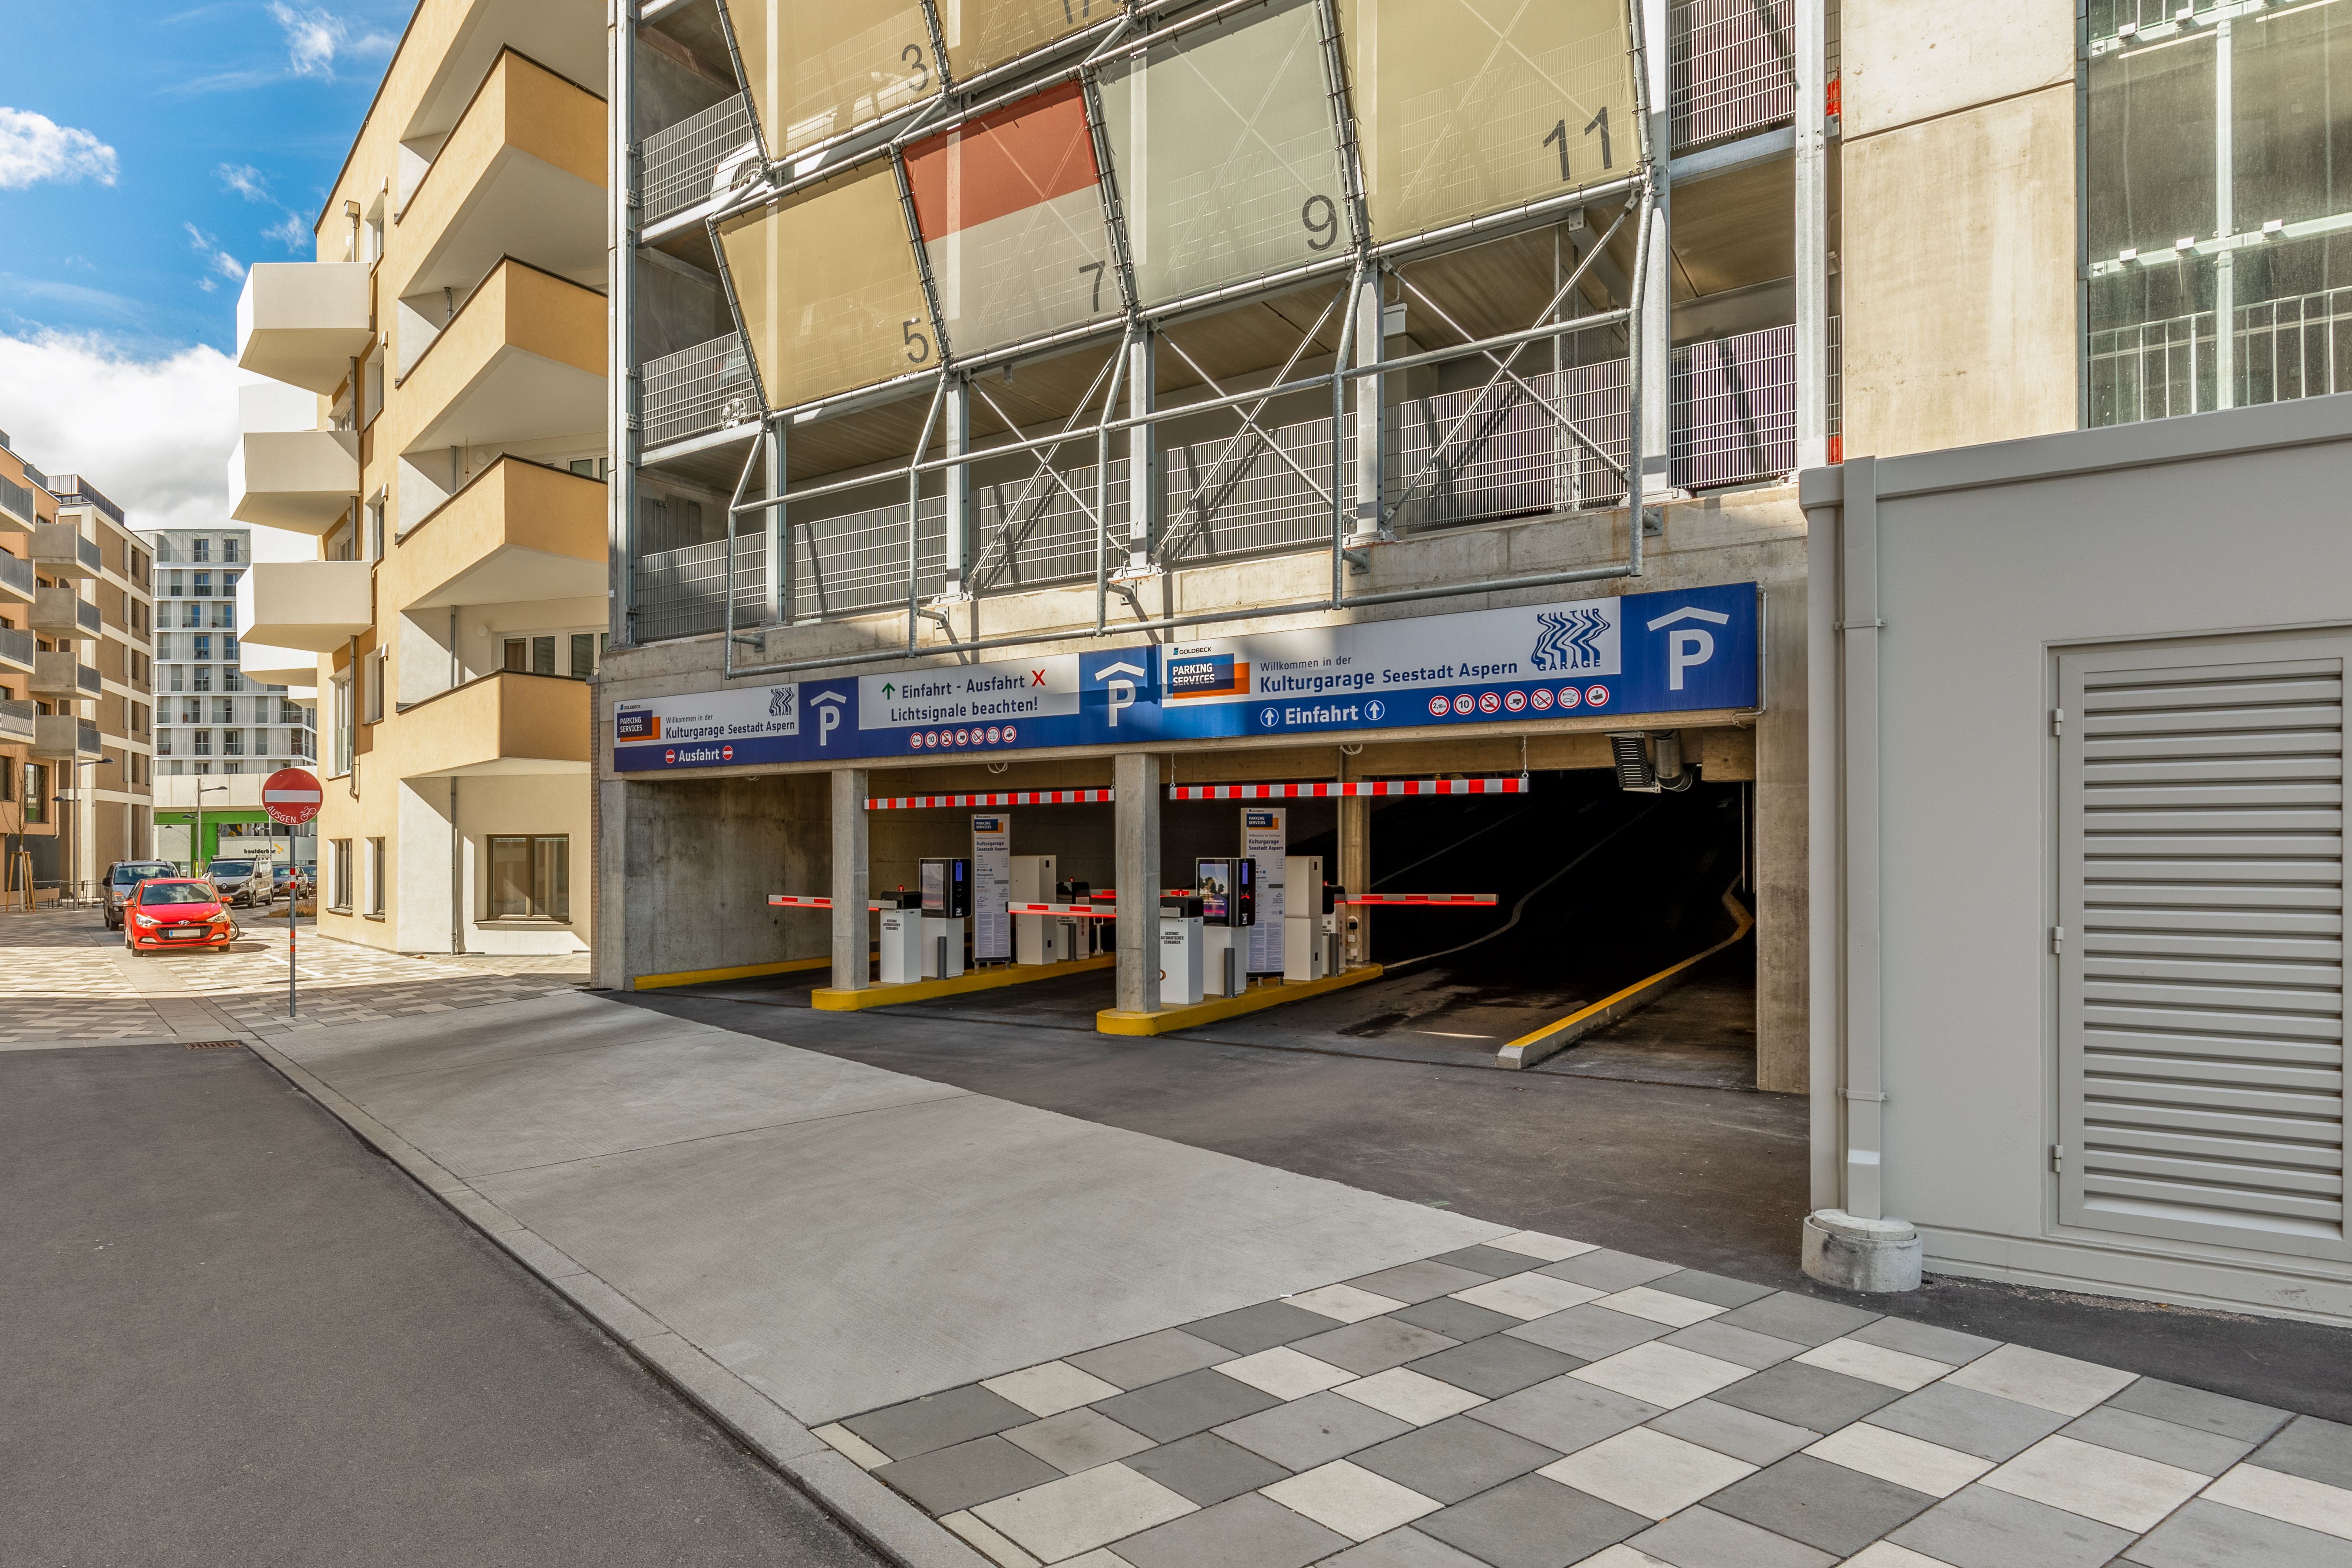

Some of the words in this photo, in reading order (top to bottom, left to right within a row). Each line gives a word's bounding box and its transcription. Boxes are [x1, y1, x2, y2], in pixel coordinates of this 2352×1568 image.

[901, 44, 928, 92] 3
[1543, 106, 1613, 182] 11
[1302, 195, 1338, 251] 9
[1079, 261, 1106, 312] 7
[903, 317, 929, 363] 5
[1173, 663, 1213, 675] PARKING
[1260, 658, 1319, 672] Willkommen
[1323, 657, 1332, 667] in
[1336, 655, 1352, 666] der
[1537, 660, 1601, 671] GARAGE
[1669, 629, 1714, 690] P
[902, 683, 952, 699] Einfahrt
[966, 675, 1025, 693] Ausfahrt
[1173, 674, 1215, 686] SERVICES
[1260, 672, 1375, 693] Kulturgarage
[1382, 665, 1453, 683] Seestadt
[1458, 663, 1518, 680] Aspern
[891, 703, 967, 723] Lichtsignale
[973, 696, 1038, 716] beachten!
[1108, 679, 1136, 726] P
[1459, 700, 1469, 709] 10
[620, 716, 641, 725] PARKING
[820, 706, 840, 746] P
[1286, 706, 1359, 725] Einfahrt
[620, 724, 643, 733] SERVICES
[666, 726, 725, 739] Kulturgarage
[728, 722, 763, 734] Seestadt
[766, 721, 795, 733] Aspern
[679, 748, 719, 762] Ausfahrt
[266, 805, 299, 823] AUSGEN.
